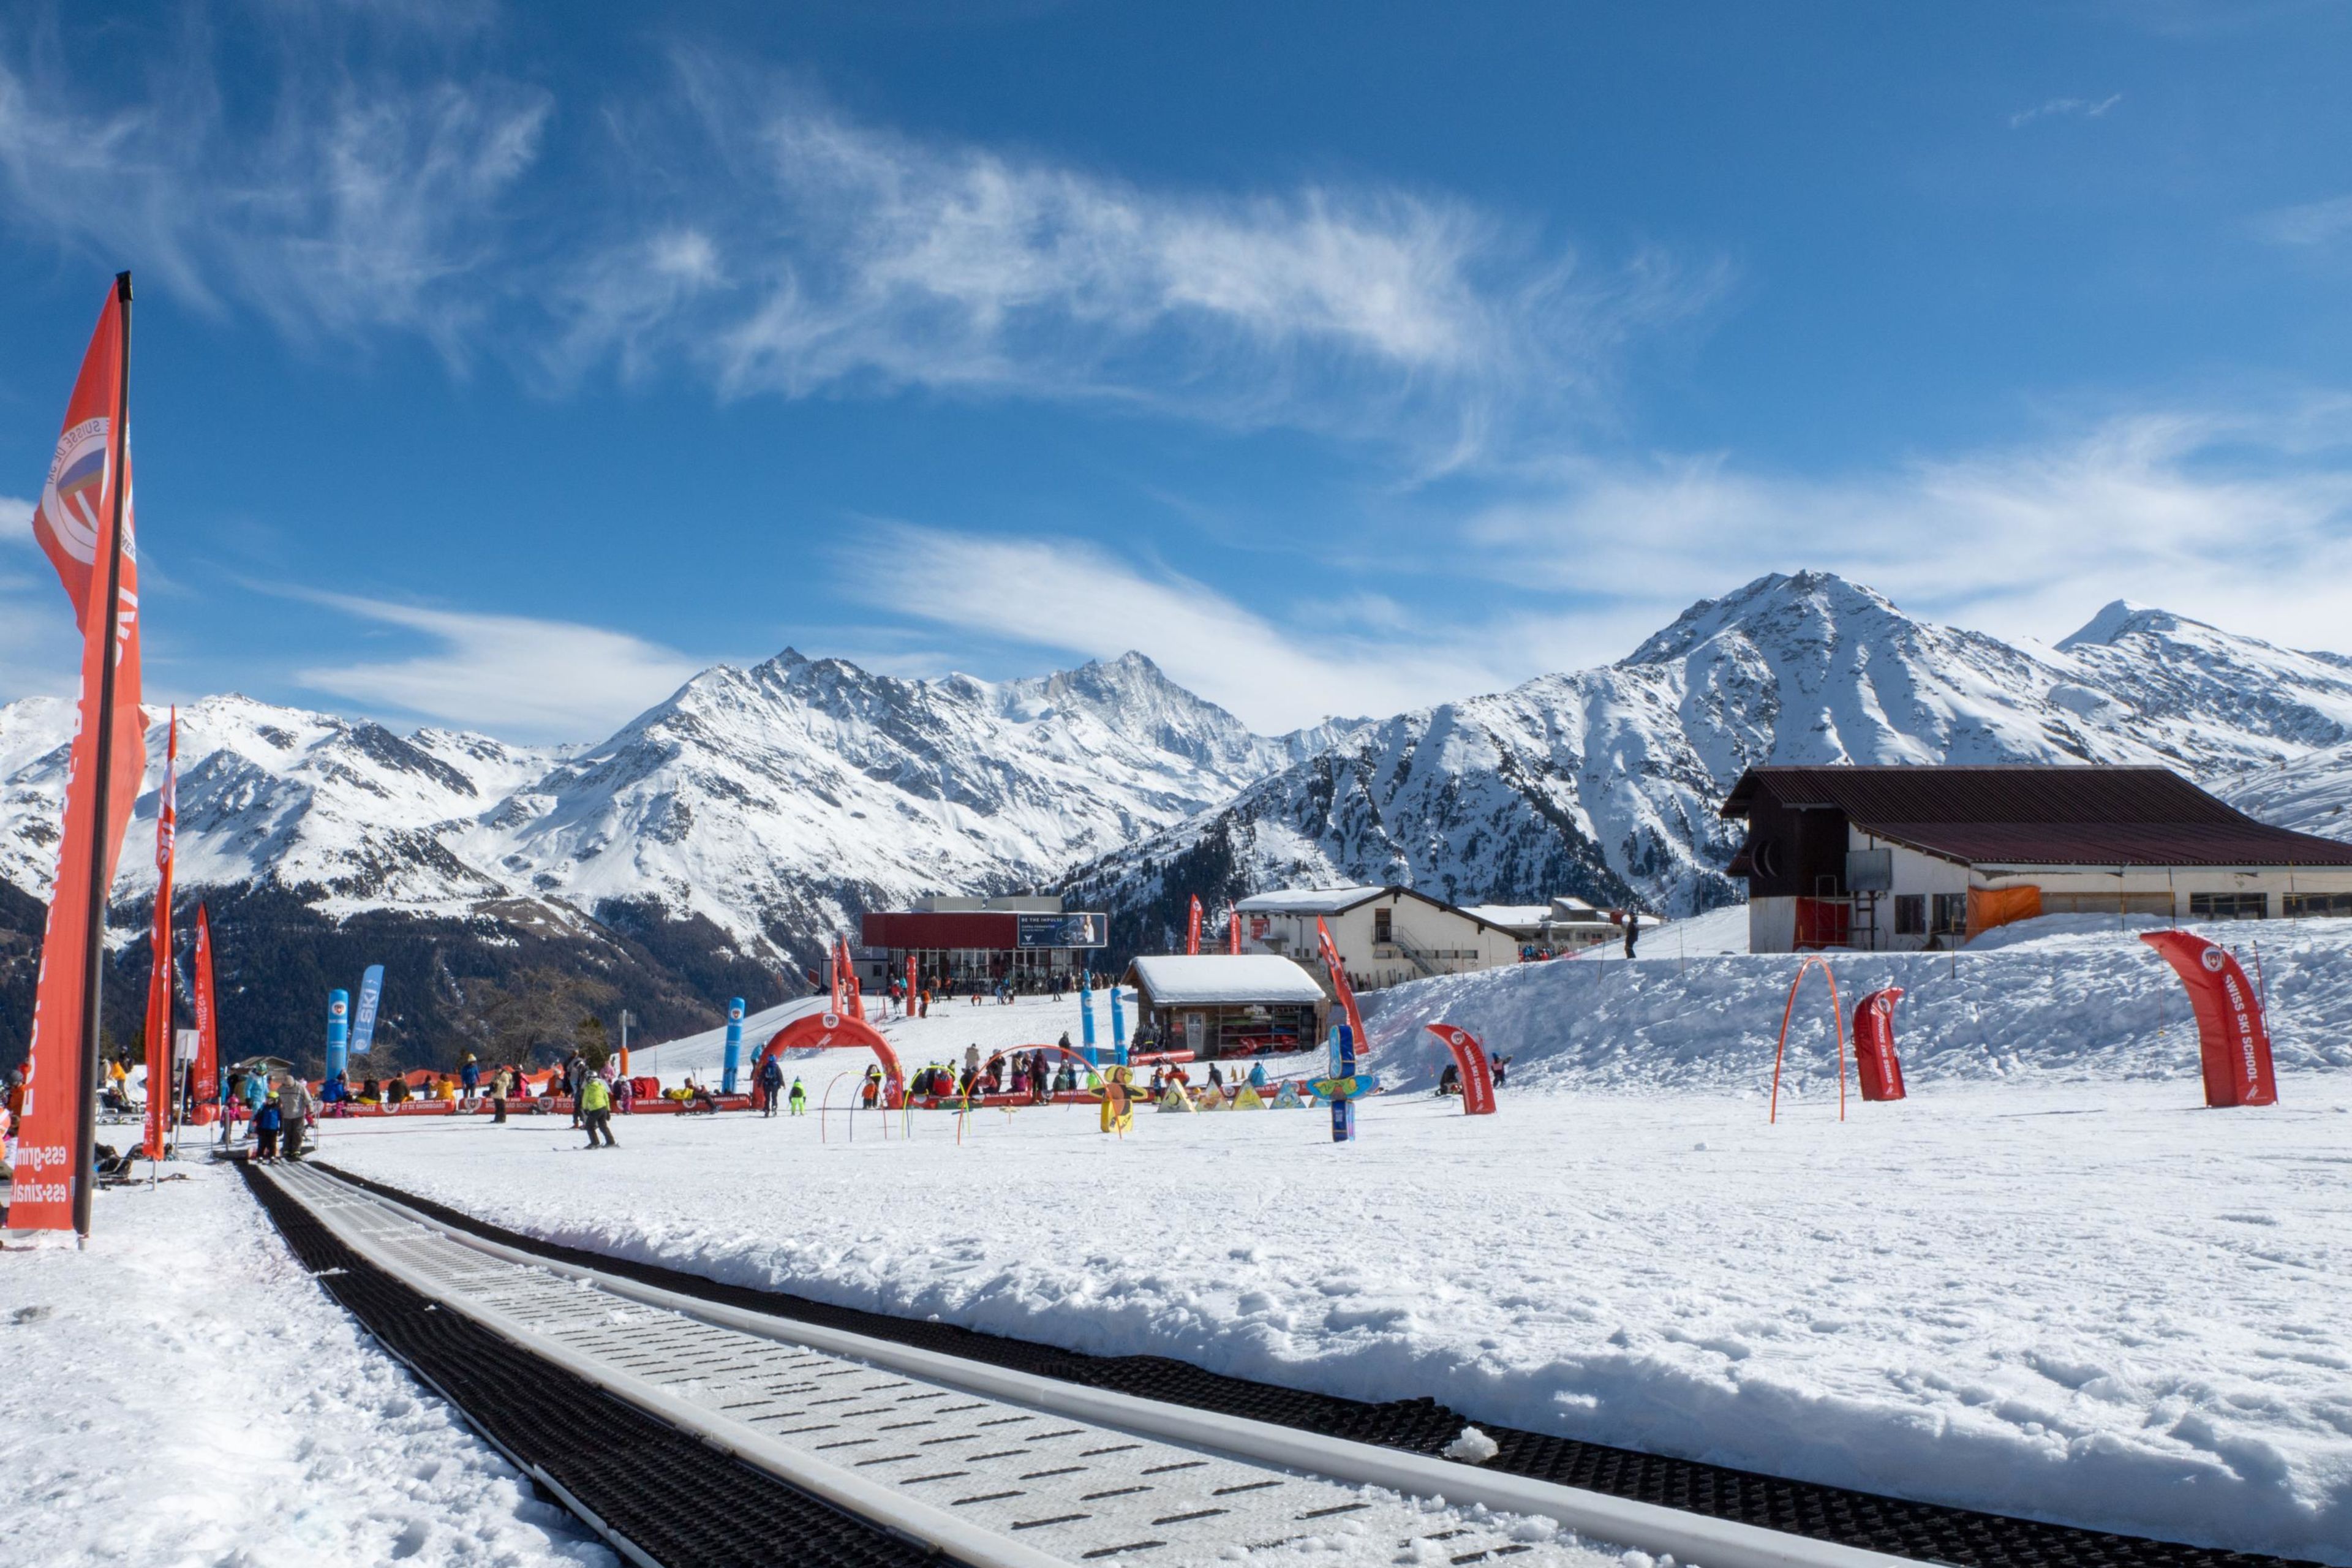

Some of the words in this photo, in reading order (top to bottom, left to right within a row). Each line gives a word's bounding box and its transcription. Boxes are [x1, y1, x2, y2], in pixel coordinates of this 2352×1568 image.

[2225, 974, 2245, 1011] SWISS
[360, 989, 377, 1030] SKI
[2237, 1013, 2251, 1033] SKI
[1464, 1045, 1476, 1066] SWISS
[2242, 1036, 2258, 1082] SCHOOL
[1471, 1065, 1480, 1077] SKI
[1883, 1059, 1894, 1084] SWISS
[1474, 1077, 1484, 1102] SCHOOL
